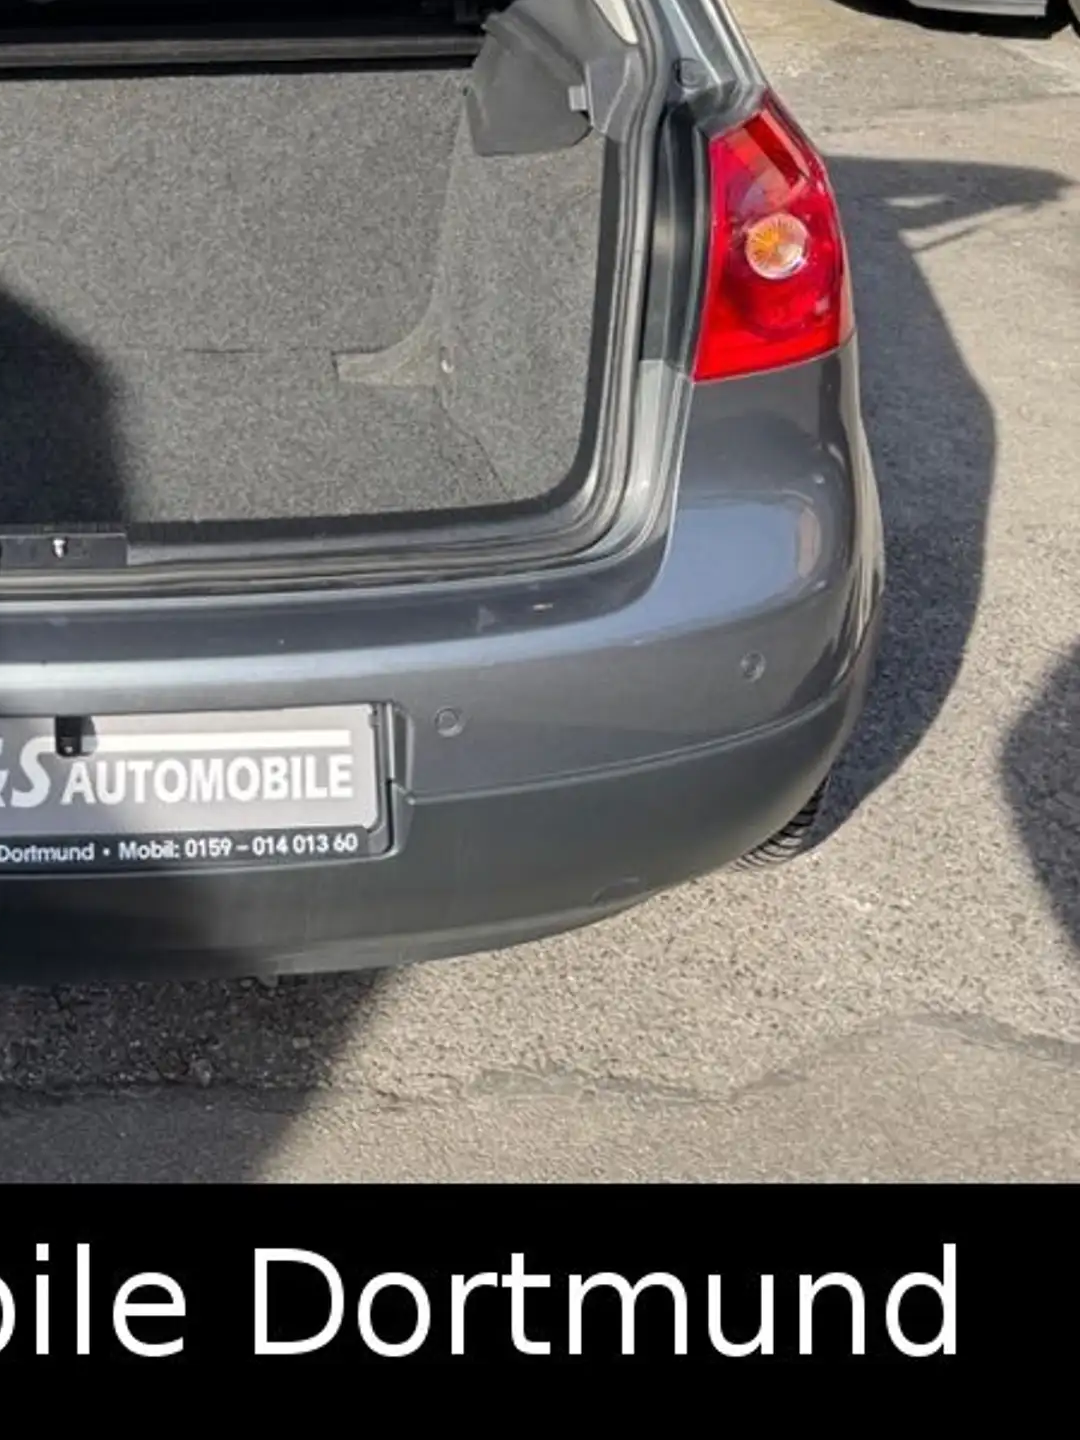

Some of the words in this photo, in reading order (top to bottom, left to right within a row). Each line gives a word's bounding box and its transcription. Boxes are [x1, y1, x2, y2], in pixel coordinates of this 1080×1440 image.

[61, 754, 354, 806] AUTOMOBILE
[118, 839, 179, 860] Mobil:
[185, 836, 232, 857] 0159
[253, 834, 288, 856] 014
[293, 832, 329, 854] 013
[333, 831, 359, 853] 60
